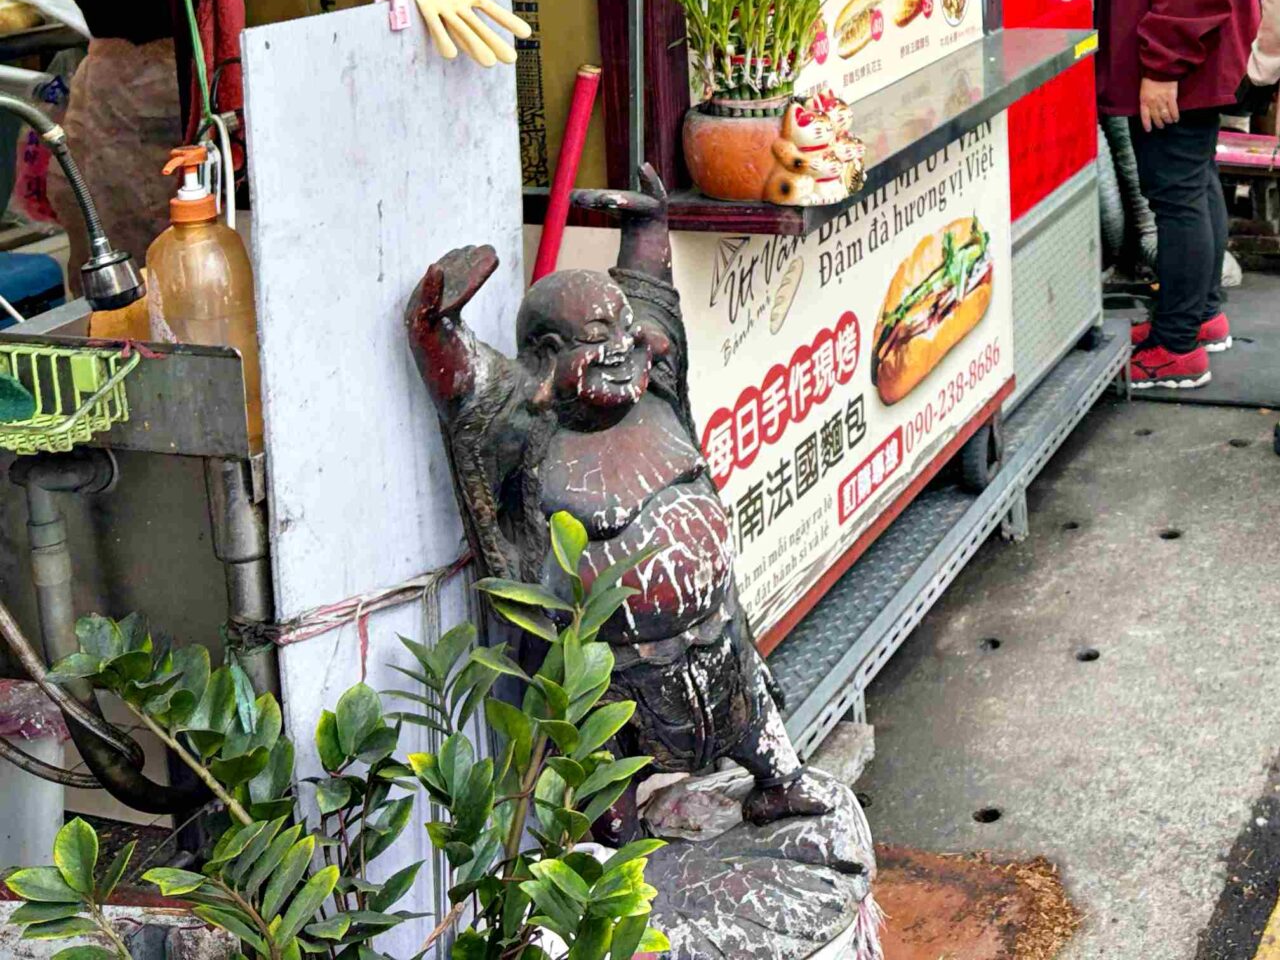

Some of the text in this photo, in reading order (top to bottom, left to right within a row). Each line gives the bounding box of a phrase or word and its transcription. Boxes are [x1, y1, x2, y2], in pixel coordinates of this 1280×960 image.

[818, 145, 995, 288] Đậm đà hương vị Việt
[705, 321, 858, 478] 每日手作現烤
[904, 337, 1001, 454] 090-238-8686
[728, 393, 868, 557] 南法國麵包
